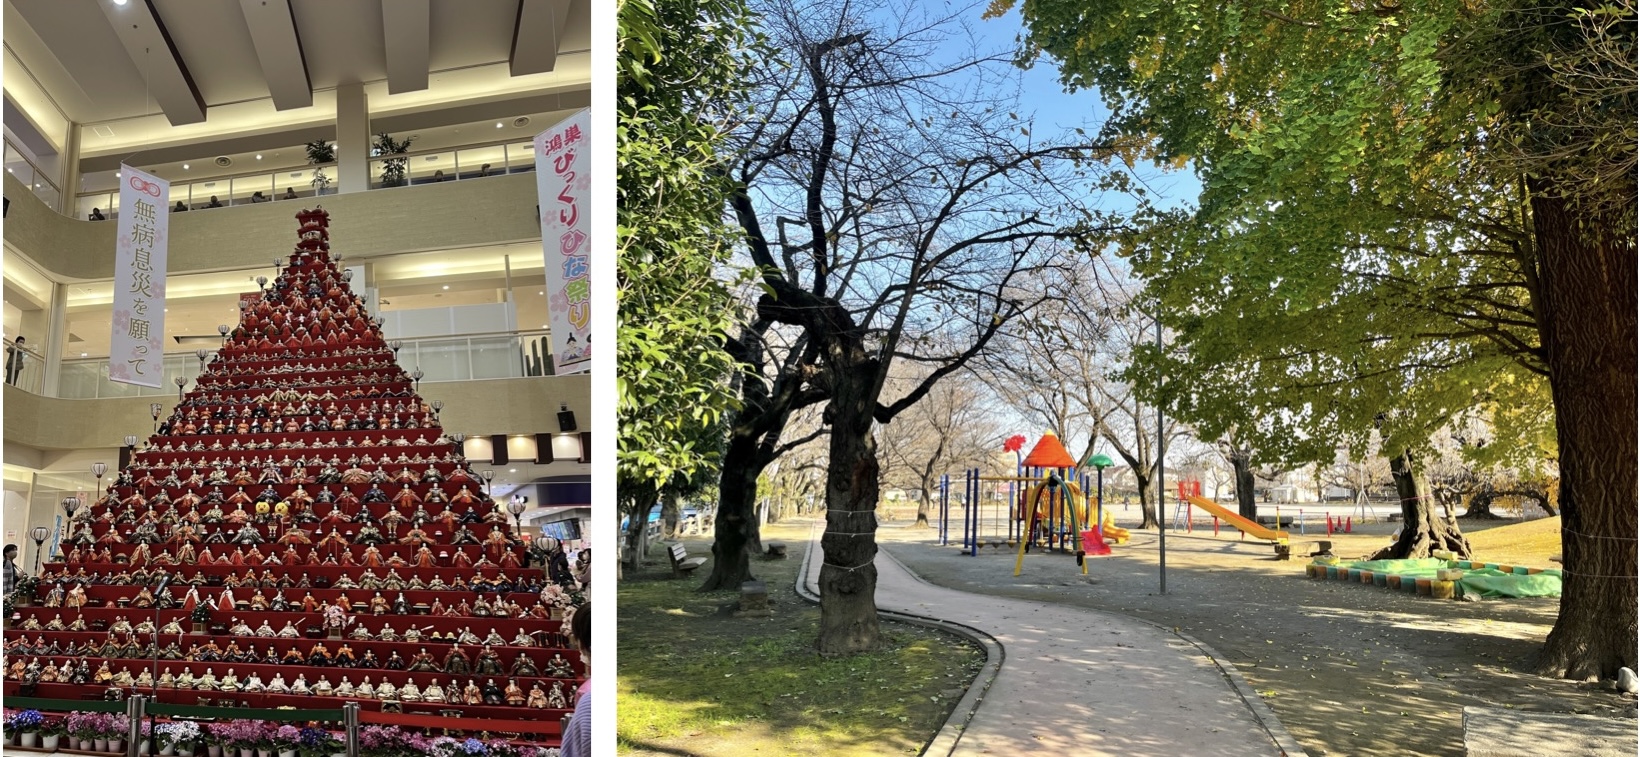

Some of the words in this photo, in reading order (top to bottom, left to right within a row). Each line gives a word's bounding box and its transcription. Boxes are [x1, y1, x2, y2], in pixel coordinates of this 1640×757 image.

[545, 123, 581, 156] 鴻巣
[127, 198, 156, 375] 無病息災を願って
